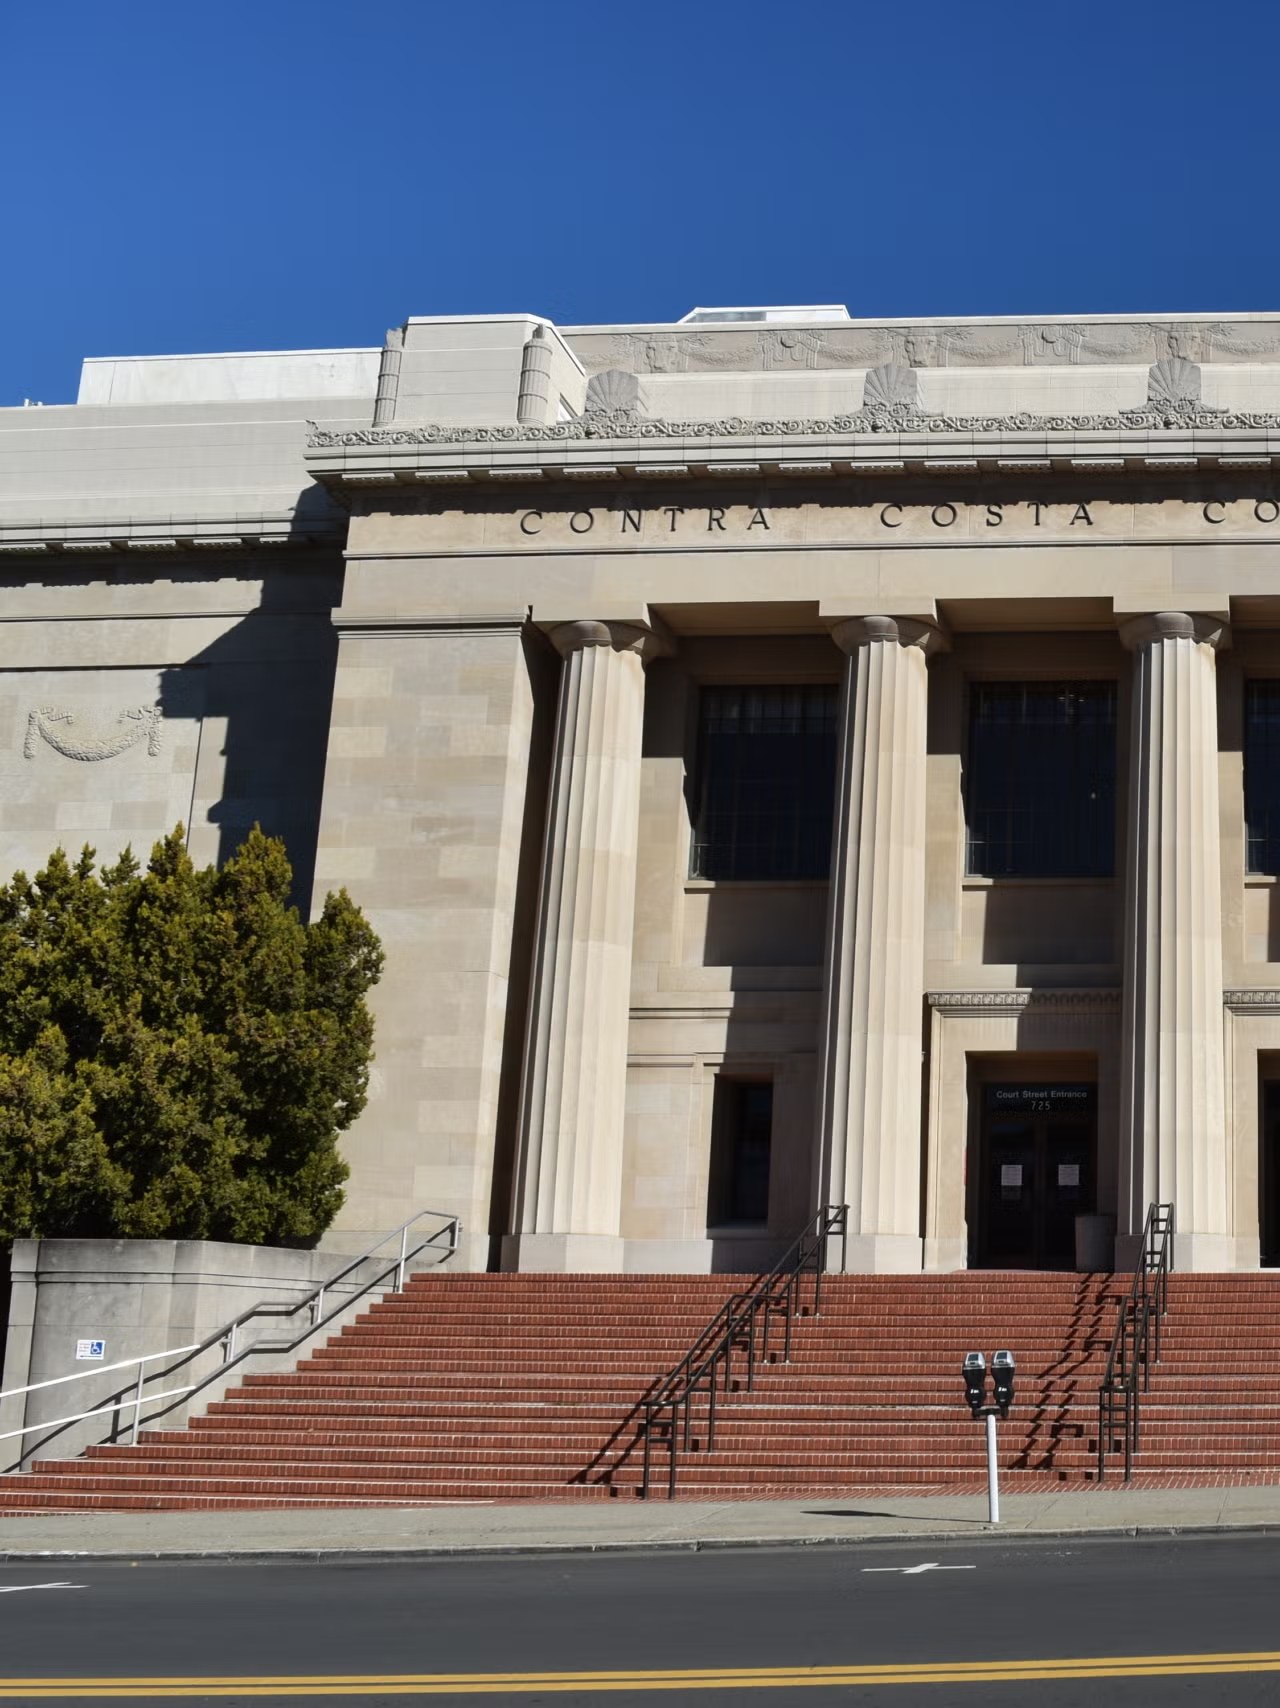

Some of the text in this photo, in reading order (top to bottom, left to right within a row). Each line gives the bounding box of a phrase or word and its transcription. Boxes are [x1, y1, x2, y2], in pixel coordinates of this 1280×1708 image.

[520, 507, 770, 535] CONTRA
[880, 502, 1093, 528] COSTA
[996, 1090, 1088, 1099] Court Street Entrance
[1031, 1100, 1051, 1111] 725
